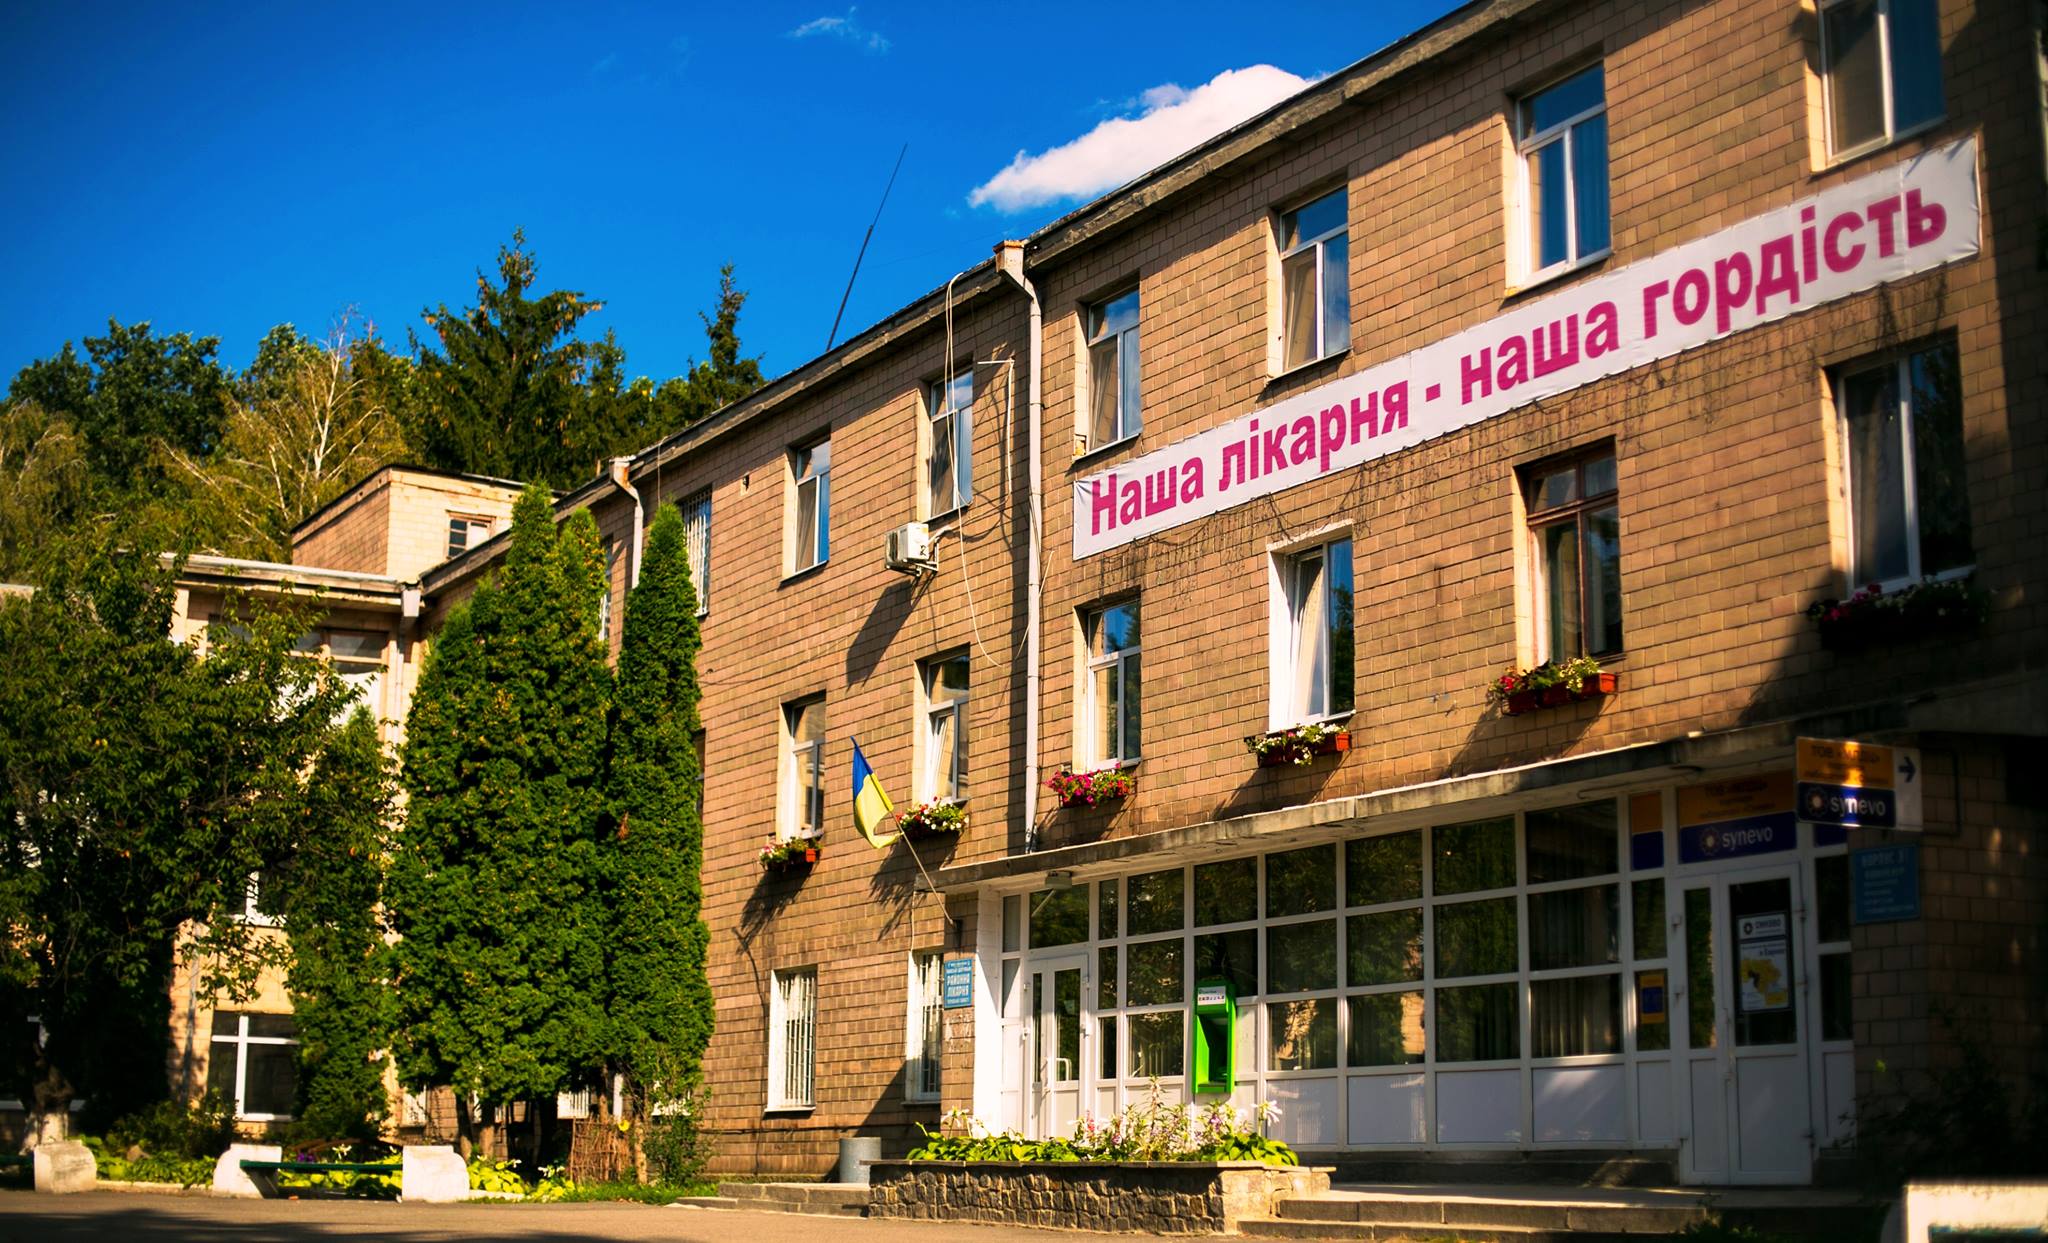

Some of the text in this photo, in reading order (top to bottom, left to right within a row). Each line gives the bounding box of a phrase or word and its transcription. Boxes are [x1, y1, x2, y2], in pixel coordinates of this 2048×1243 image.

[1091, 187, 1947, 536] Наша лікарня - наша гордість
[1829, 794, 1886, 818] synevo
[1721, 825, 1774, 851] synevo
